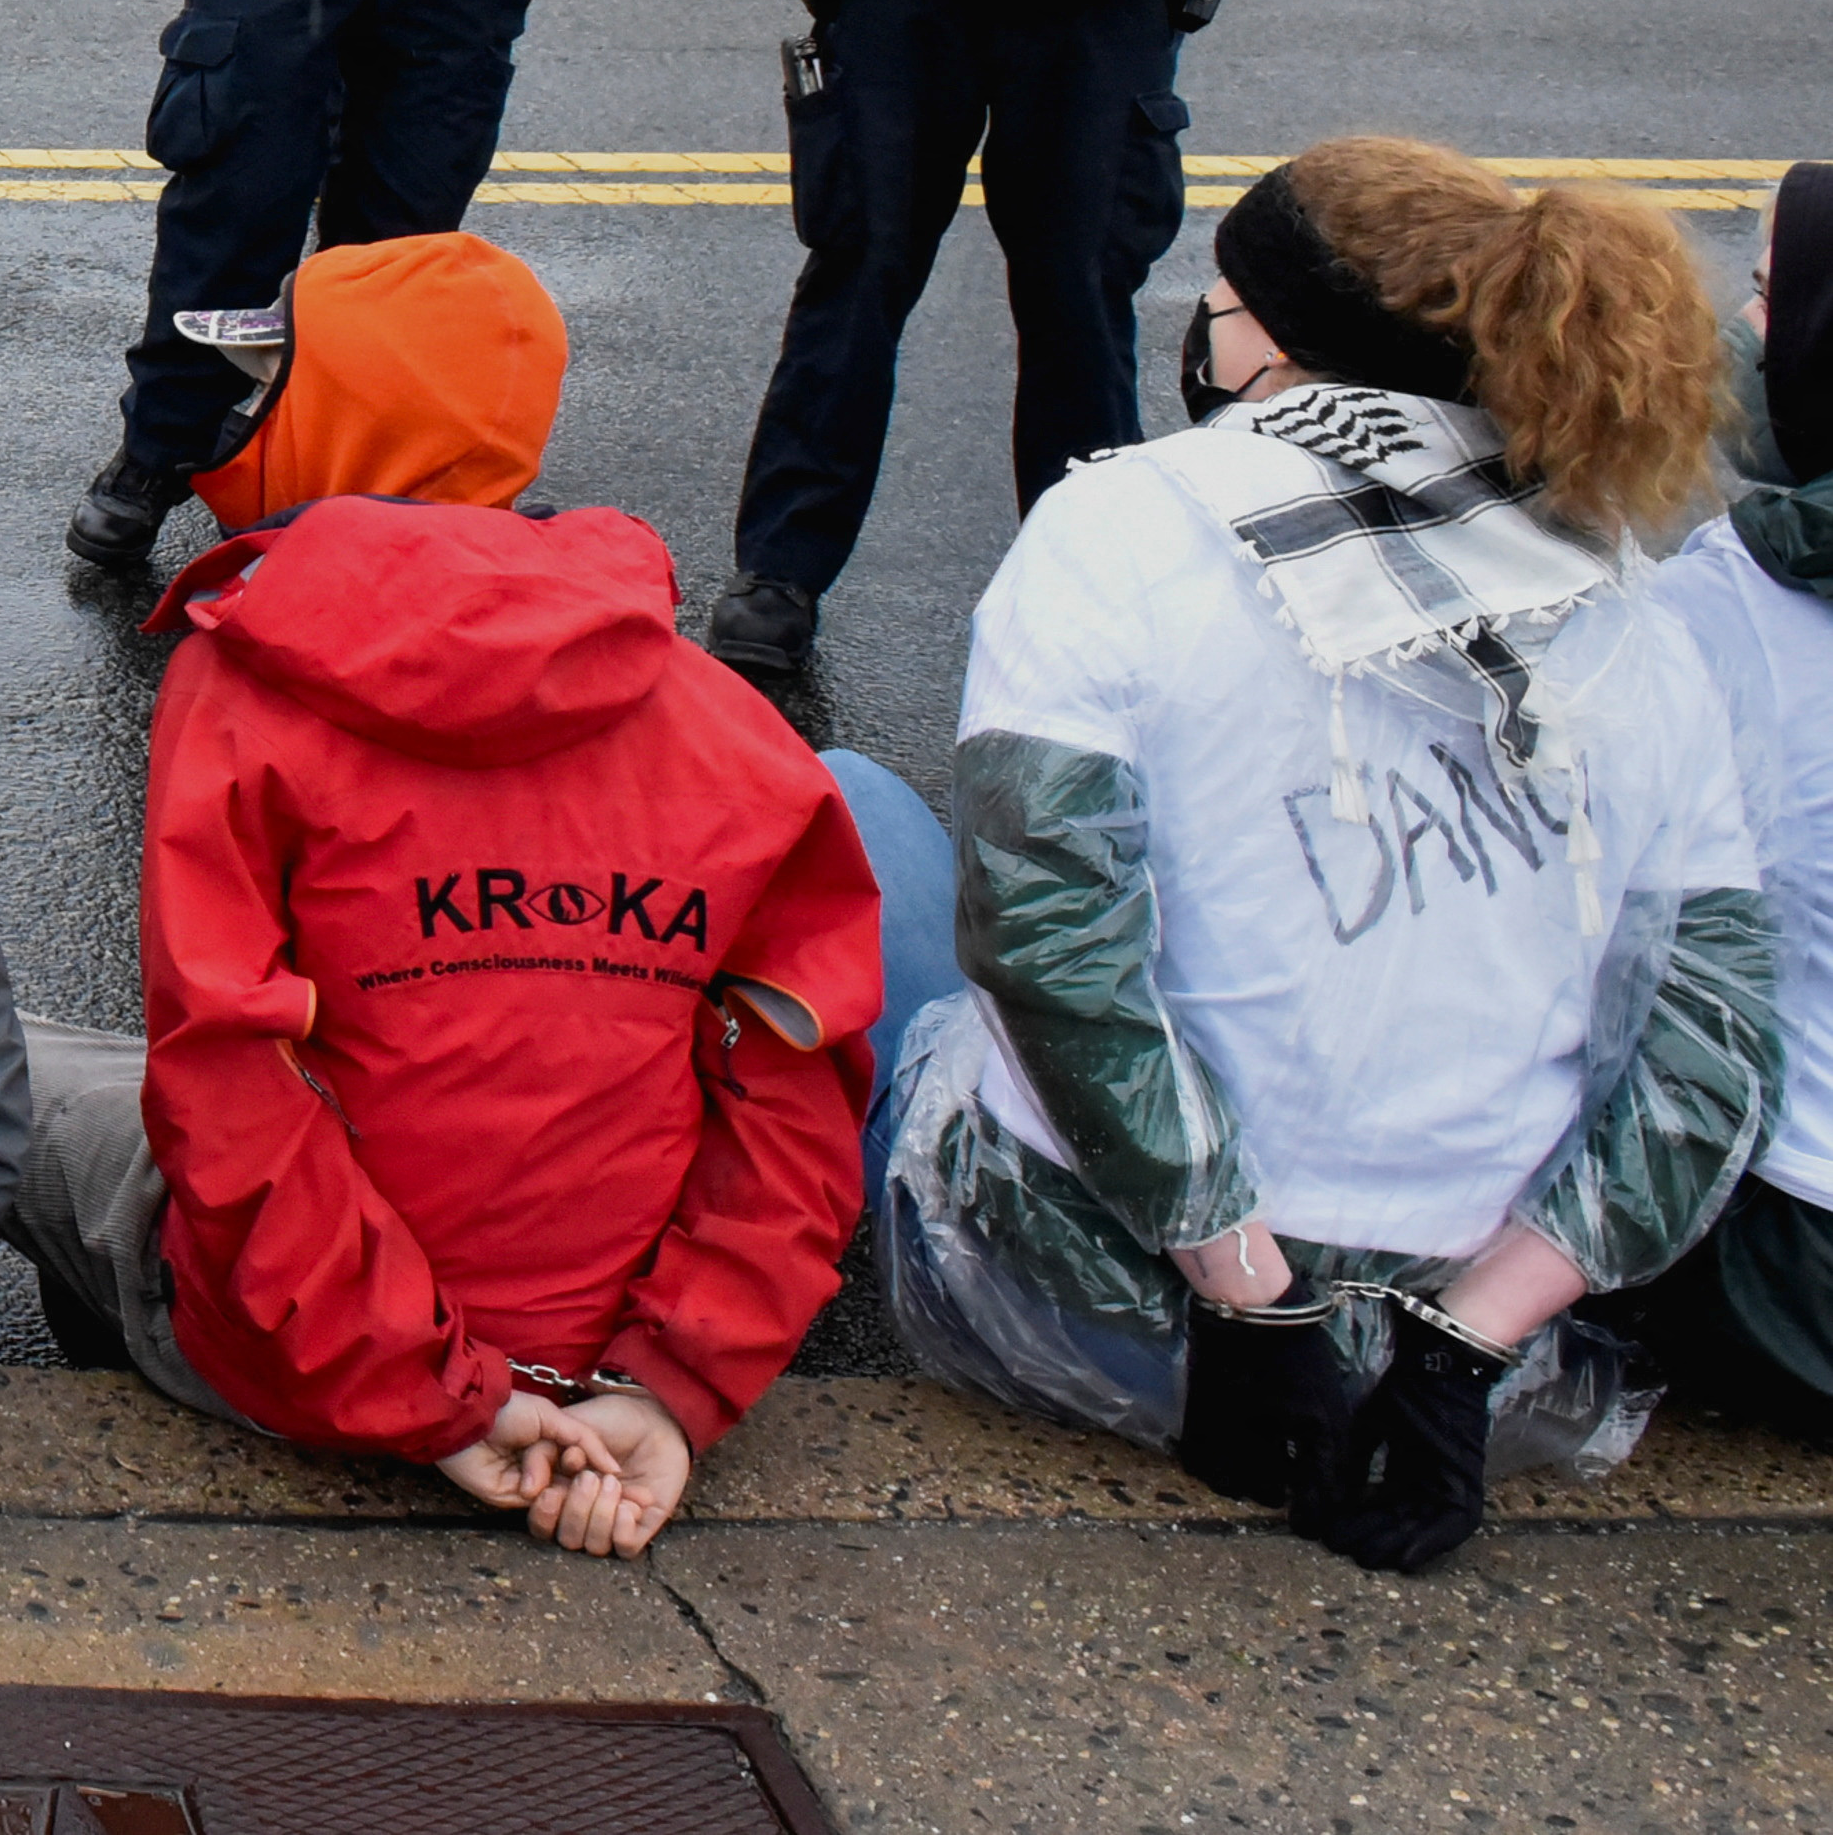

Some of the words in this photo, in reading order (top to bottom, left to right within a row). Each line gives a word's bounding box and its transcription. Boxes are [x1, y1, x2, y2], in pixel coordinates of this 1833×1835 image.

[355, 966, 425, 991] Where
[430, 954, 585, 976] Consciousness
[592, 956, 649, 980] Meets
